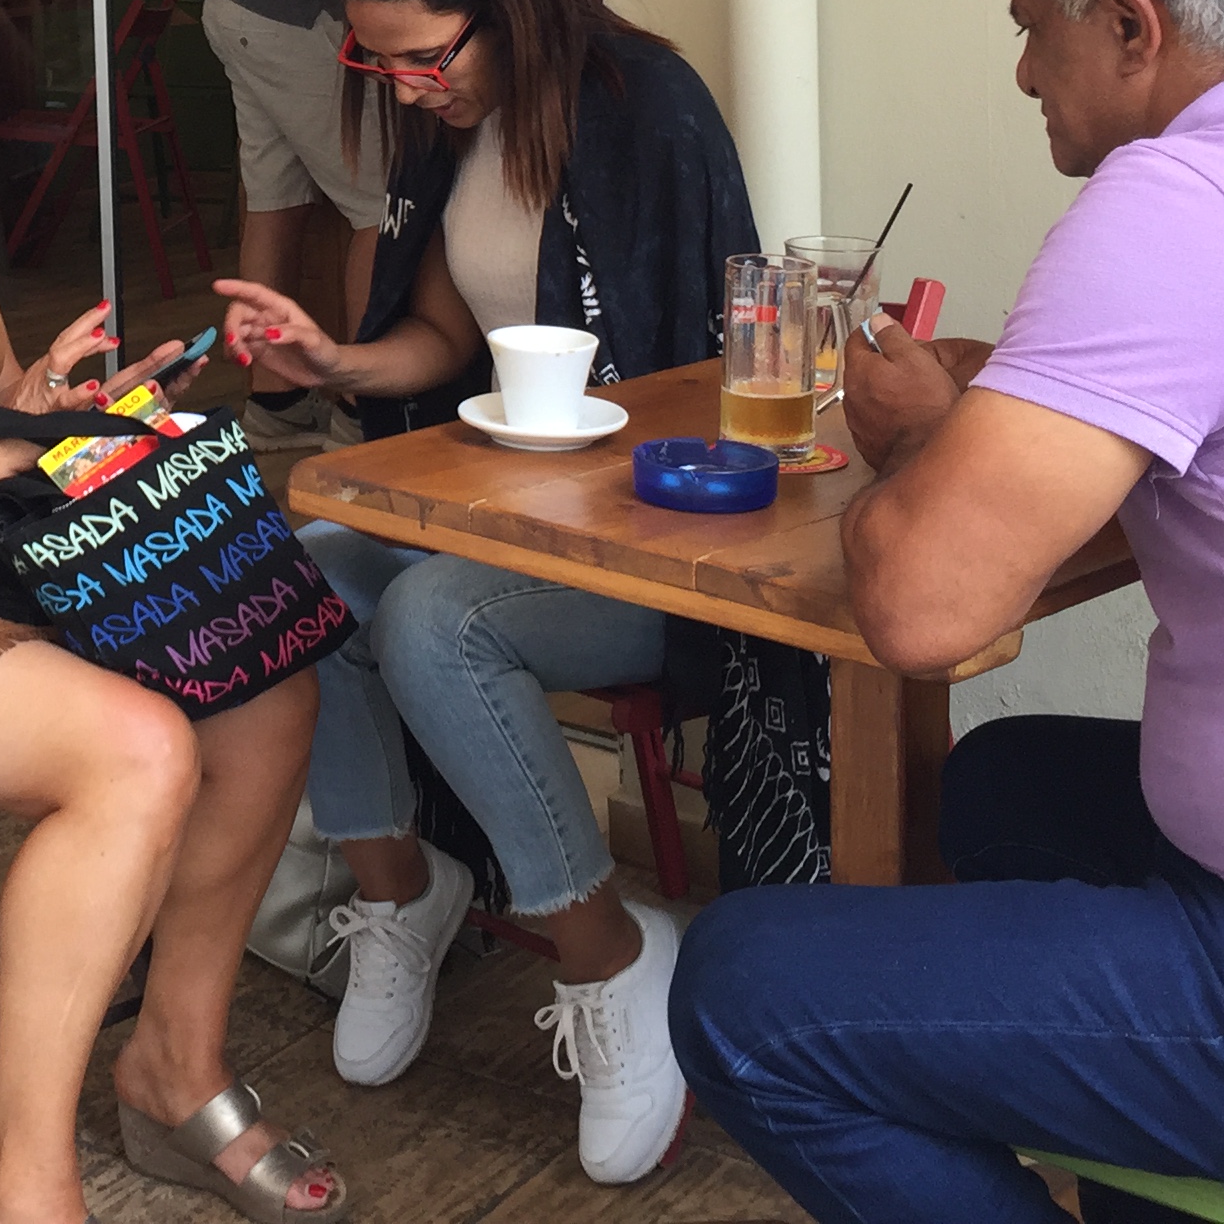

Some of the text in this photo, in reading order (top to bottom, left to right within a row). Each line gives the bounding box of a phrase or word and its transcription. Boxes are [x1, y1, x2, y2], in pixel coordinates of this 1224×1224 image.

[115, 394, 141, 415] OLO
[91, 582, 201, 652] ASADA
[198, 510, 291, 594] MASAD
[102, 493, 233, 587] MASADA
[165, 577, 299, 674] MASADA
[260, 591, 348, 677] MASAD
